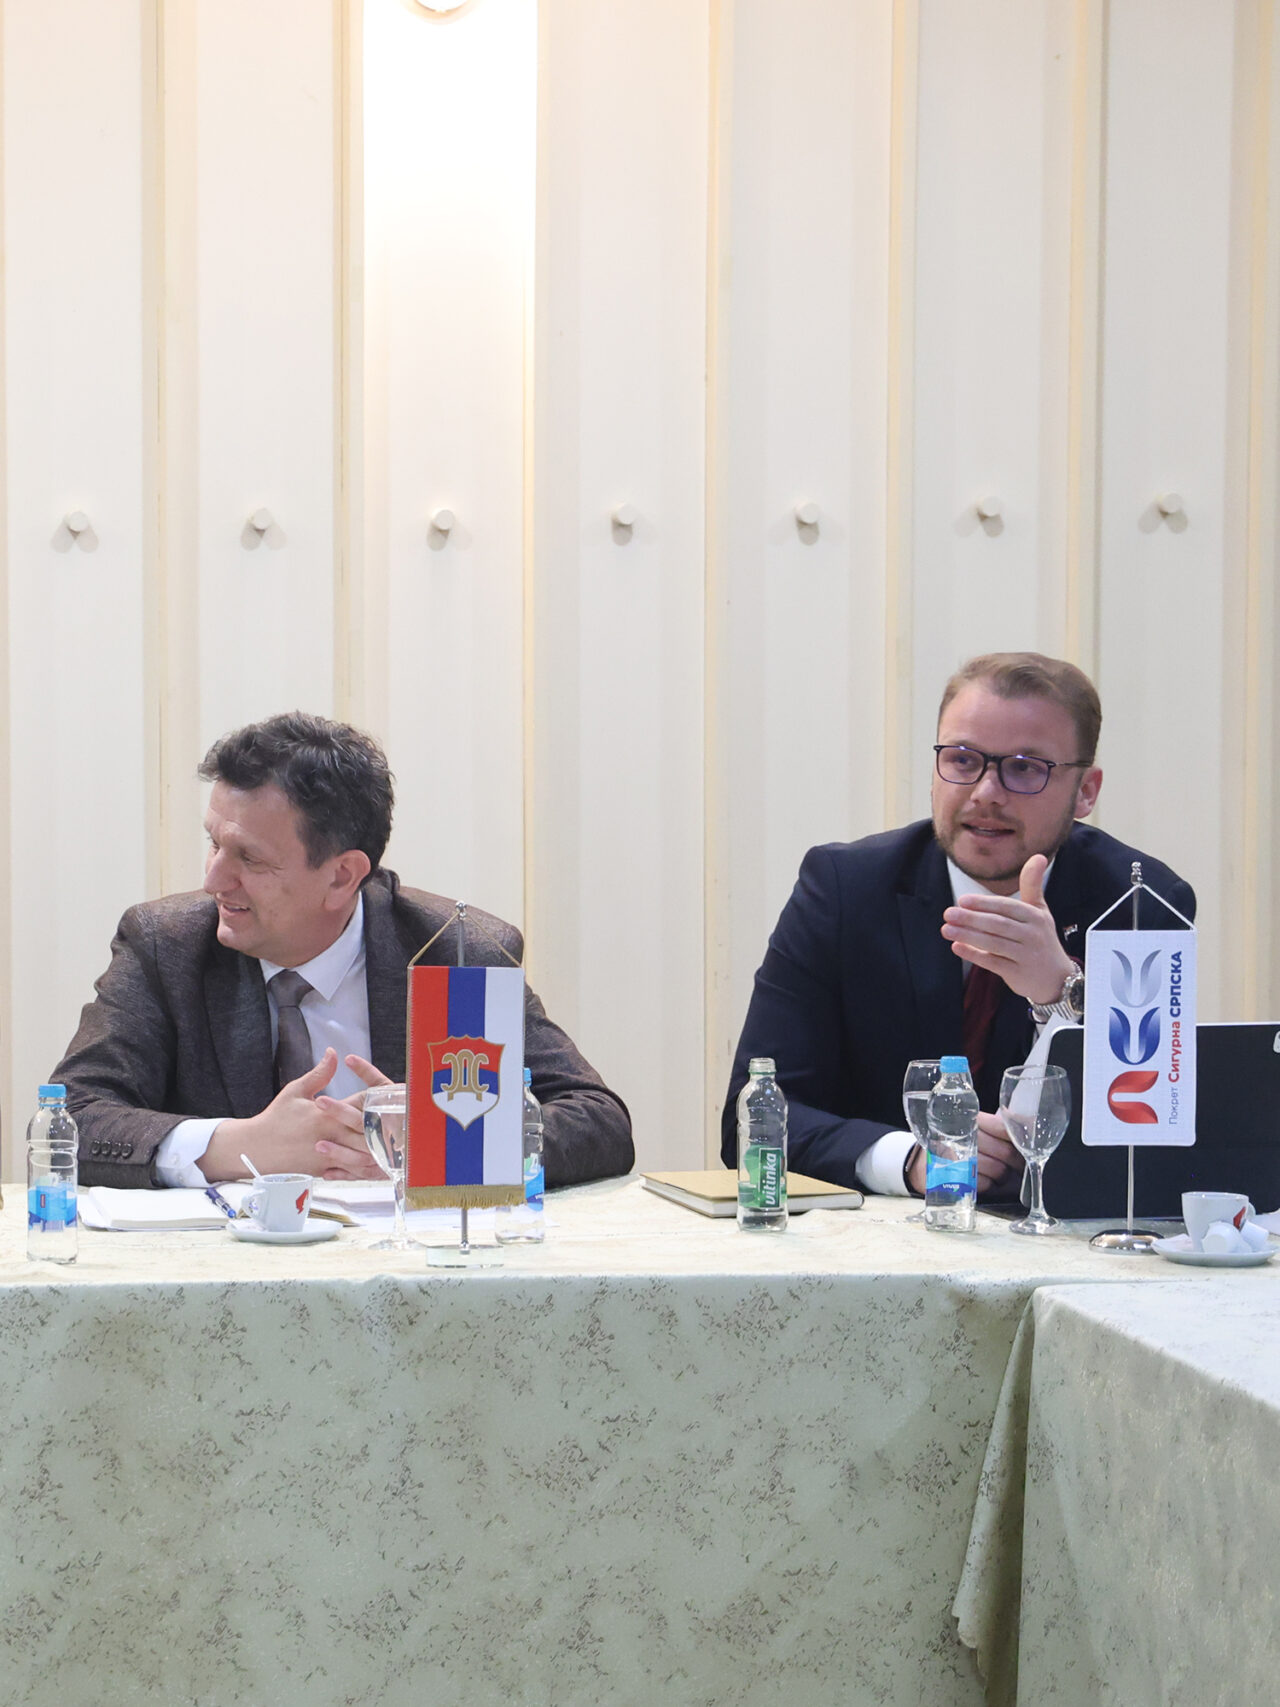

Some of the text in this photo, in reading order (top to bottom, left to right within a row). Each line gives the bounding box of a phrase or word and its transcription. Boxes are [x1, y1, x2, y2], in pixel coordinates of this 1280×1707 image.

[1168, 951, 1182, 1125] Покрет Сигурна СРПСКА
[762, 1152, 777, 1205] vitinka
